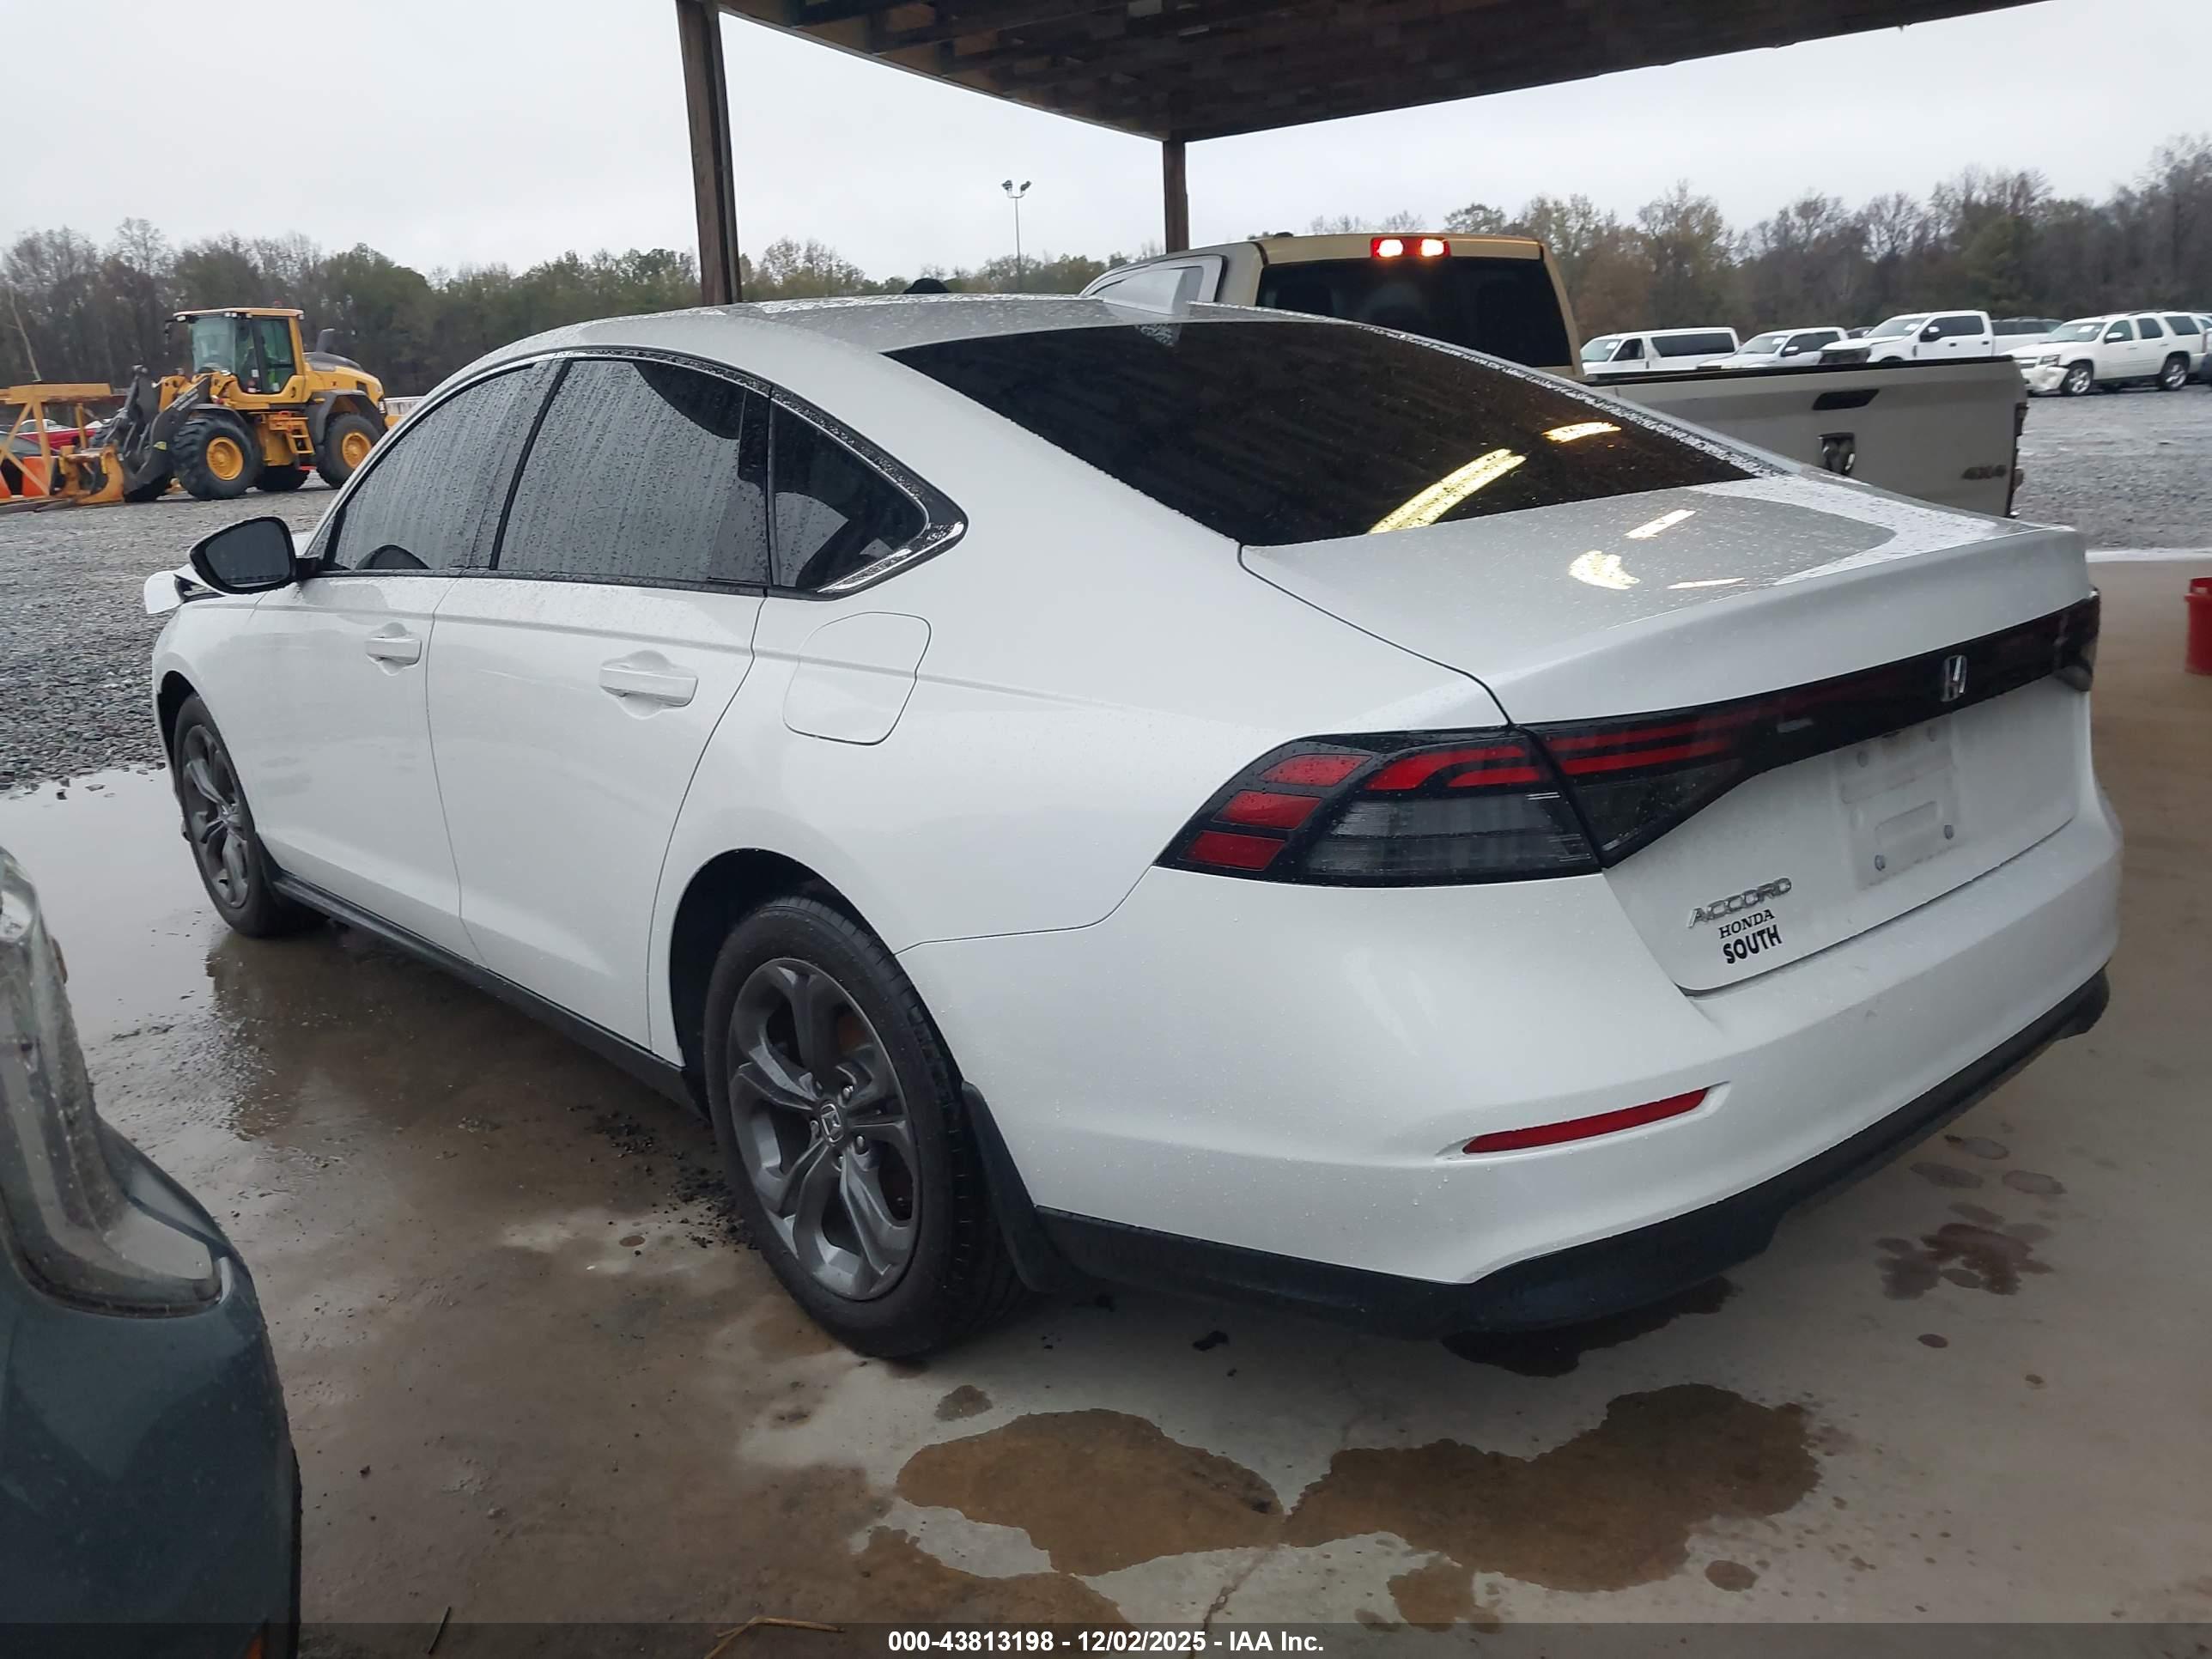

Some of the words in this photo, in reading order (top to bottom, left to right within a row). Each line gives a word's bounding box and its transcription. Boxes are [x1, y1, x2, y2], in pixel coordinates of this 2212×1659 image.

[1686, 877, 1793, 930] ACCORD
[1718, 908, 1776, 939] HONDA
[1723, 924, 1783, 964] SOUTH
